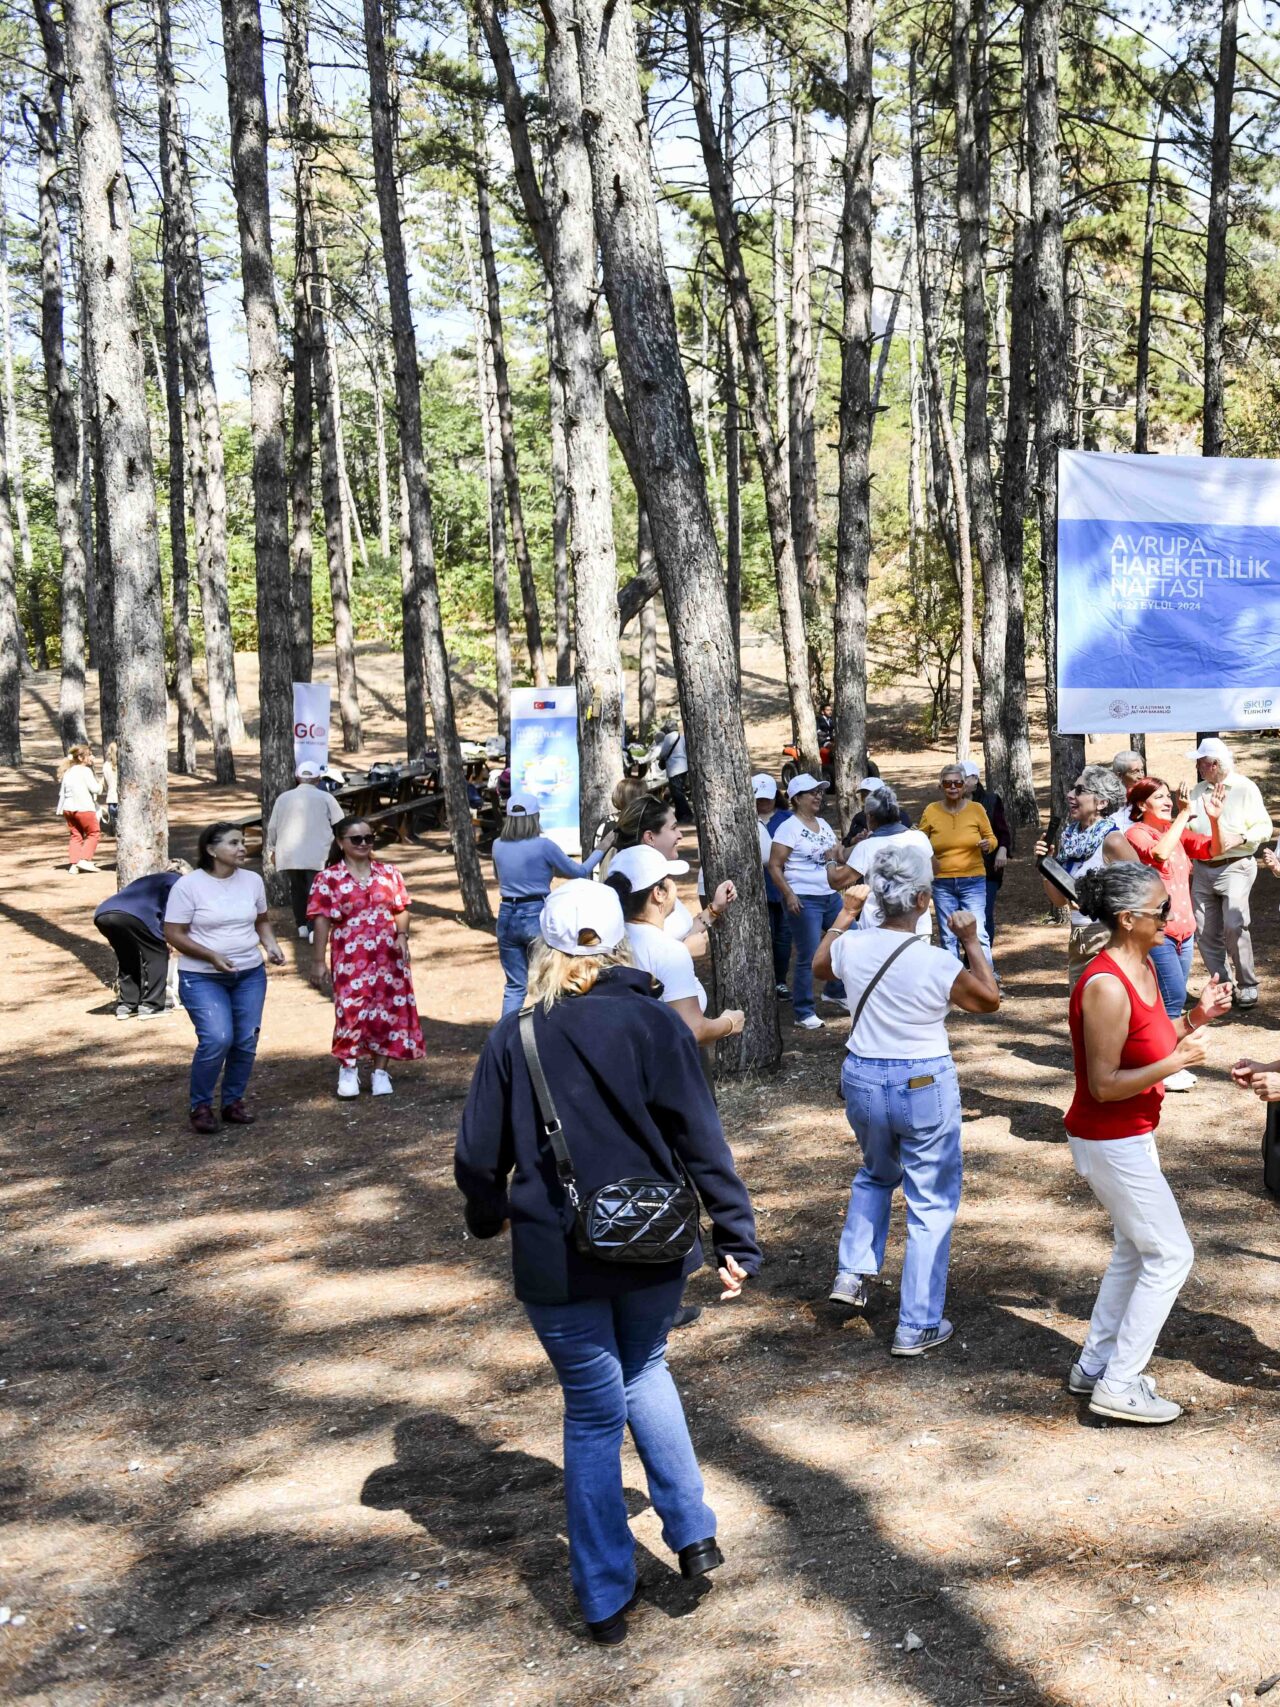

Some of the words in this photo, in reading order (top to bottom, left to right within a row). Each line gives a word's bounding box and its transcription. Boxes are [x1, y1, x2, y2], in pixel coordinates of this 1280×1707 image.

[1110, 534, 1207, 557] AVRUPA
[1111, 555, 1271, 579] HAREKETLİLİK
[1110, 577, 1204, 598] HAFTASI
[1140, 600, 1175, 610] EYLÜL
[1177, 601, 1201, 611] 2024
